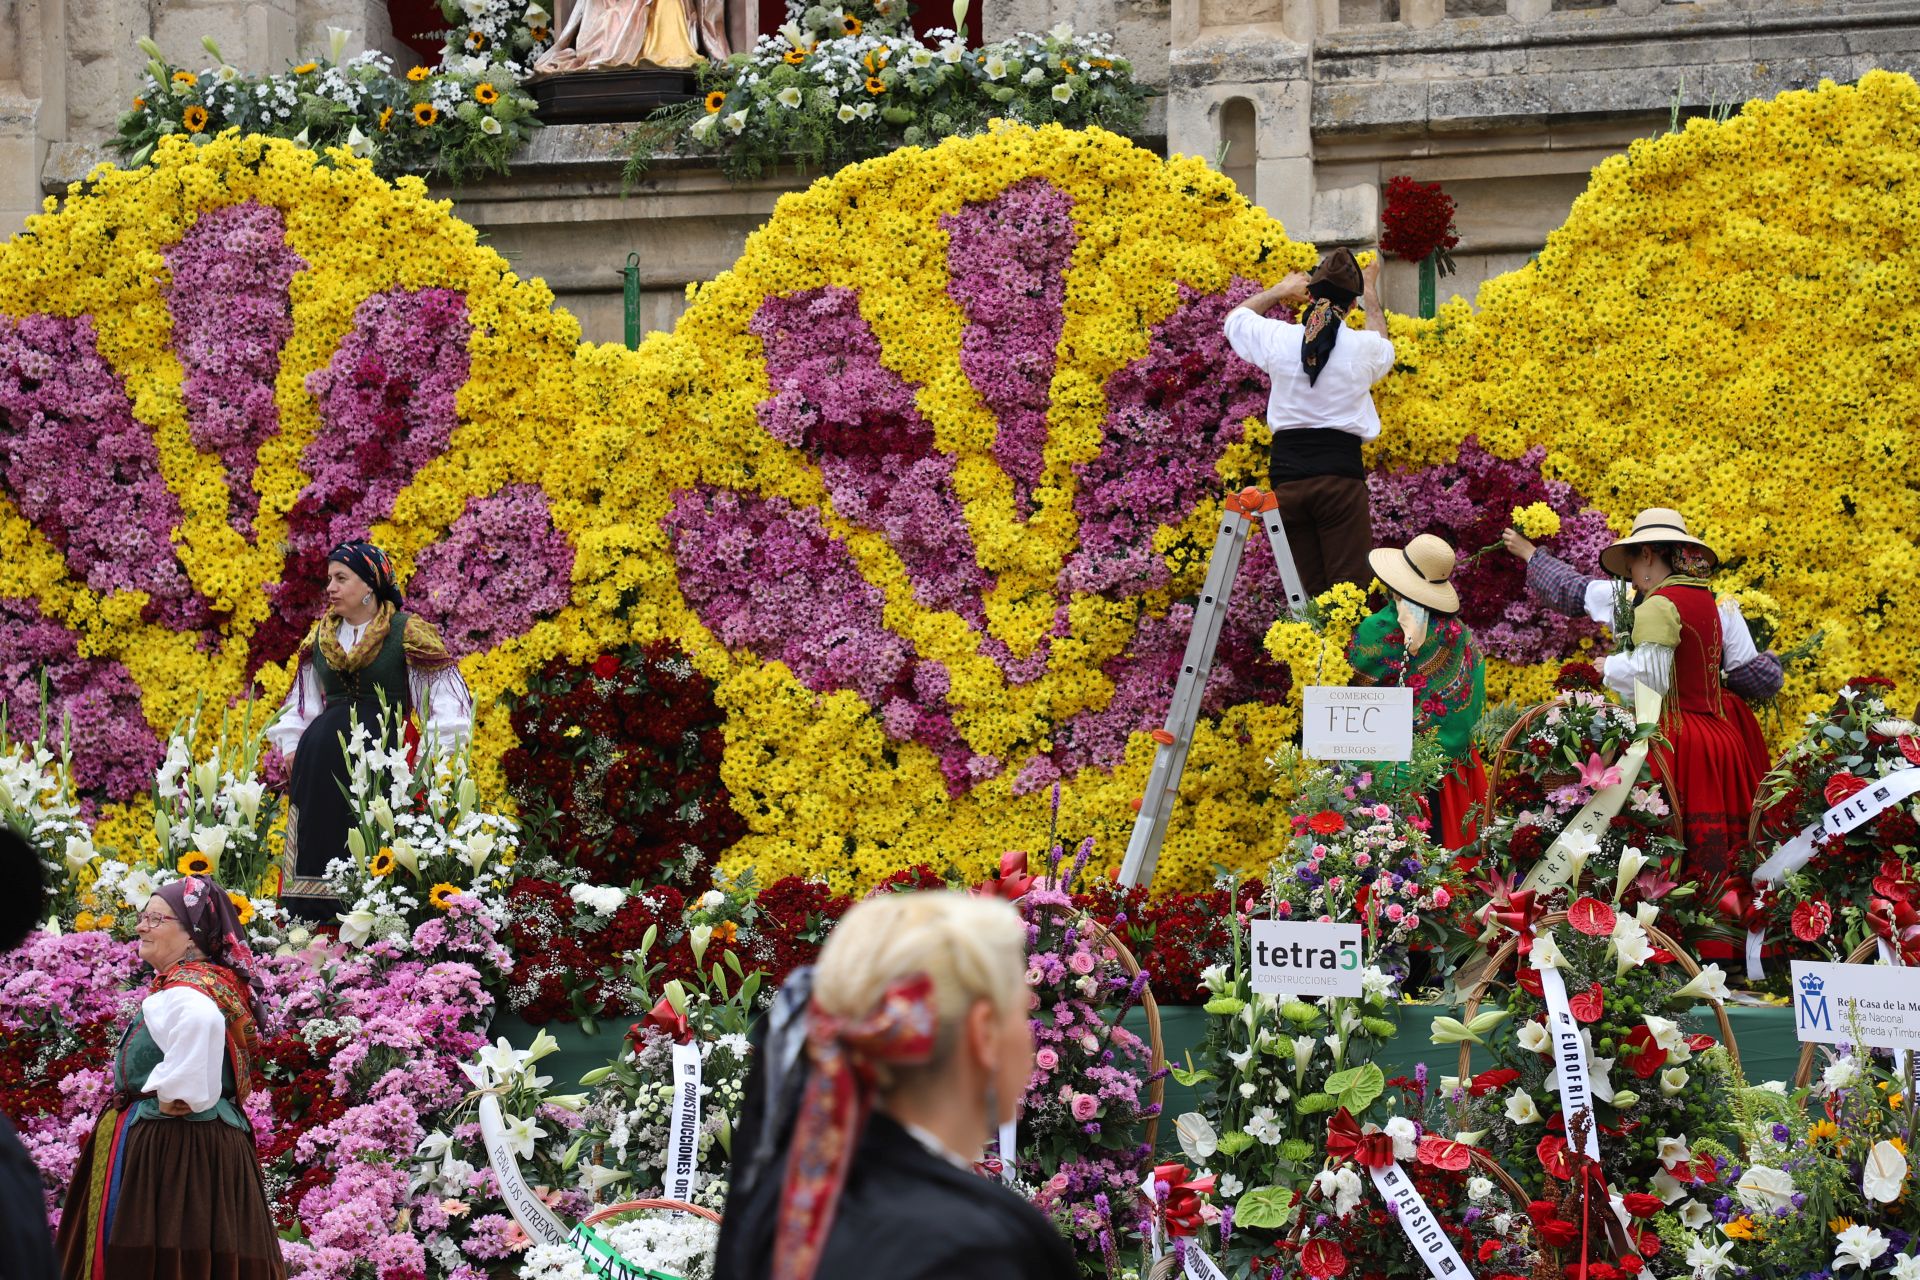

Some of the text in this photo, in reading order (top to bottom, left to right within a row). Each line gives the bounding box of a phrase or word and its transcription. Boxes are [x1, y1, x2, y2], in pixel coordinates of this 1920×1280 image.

[1329, 692, 1385, 701] COMERCIO
[1325, 705, 1381, 733] FEC
[1333, 745, 1377, 755] BURGOS
[1831, 799, 1868, 828] FAE
[1256, 940, 1358, 971] tetra5
[1257, 974, 1338, 986] CONSTRUCCIONES
[1837, 998, 1857, 1008] Rel
[1860, 999, 1881, 1009] Casa
[1883, 1000, 1895, 1010] de
[1897, 1001, 1906, 1011] la
[1838, 1010, 1904, 1024] Fáica Nacional
[1840, 1024, 1850, 1033] de
[1887, 1029, 1893, 1038] y
[677, 1082, 697, 1175] CONSTRUCCIONES
[494, 1145, 510, 1177] PEÑA
[506, 1176, 523, 1201] LOS
[1394, 1188, 1443, 1253] PEPSICO
